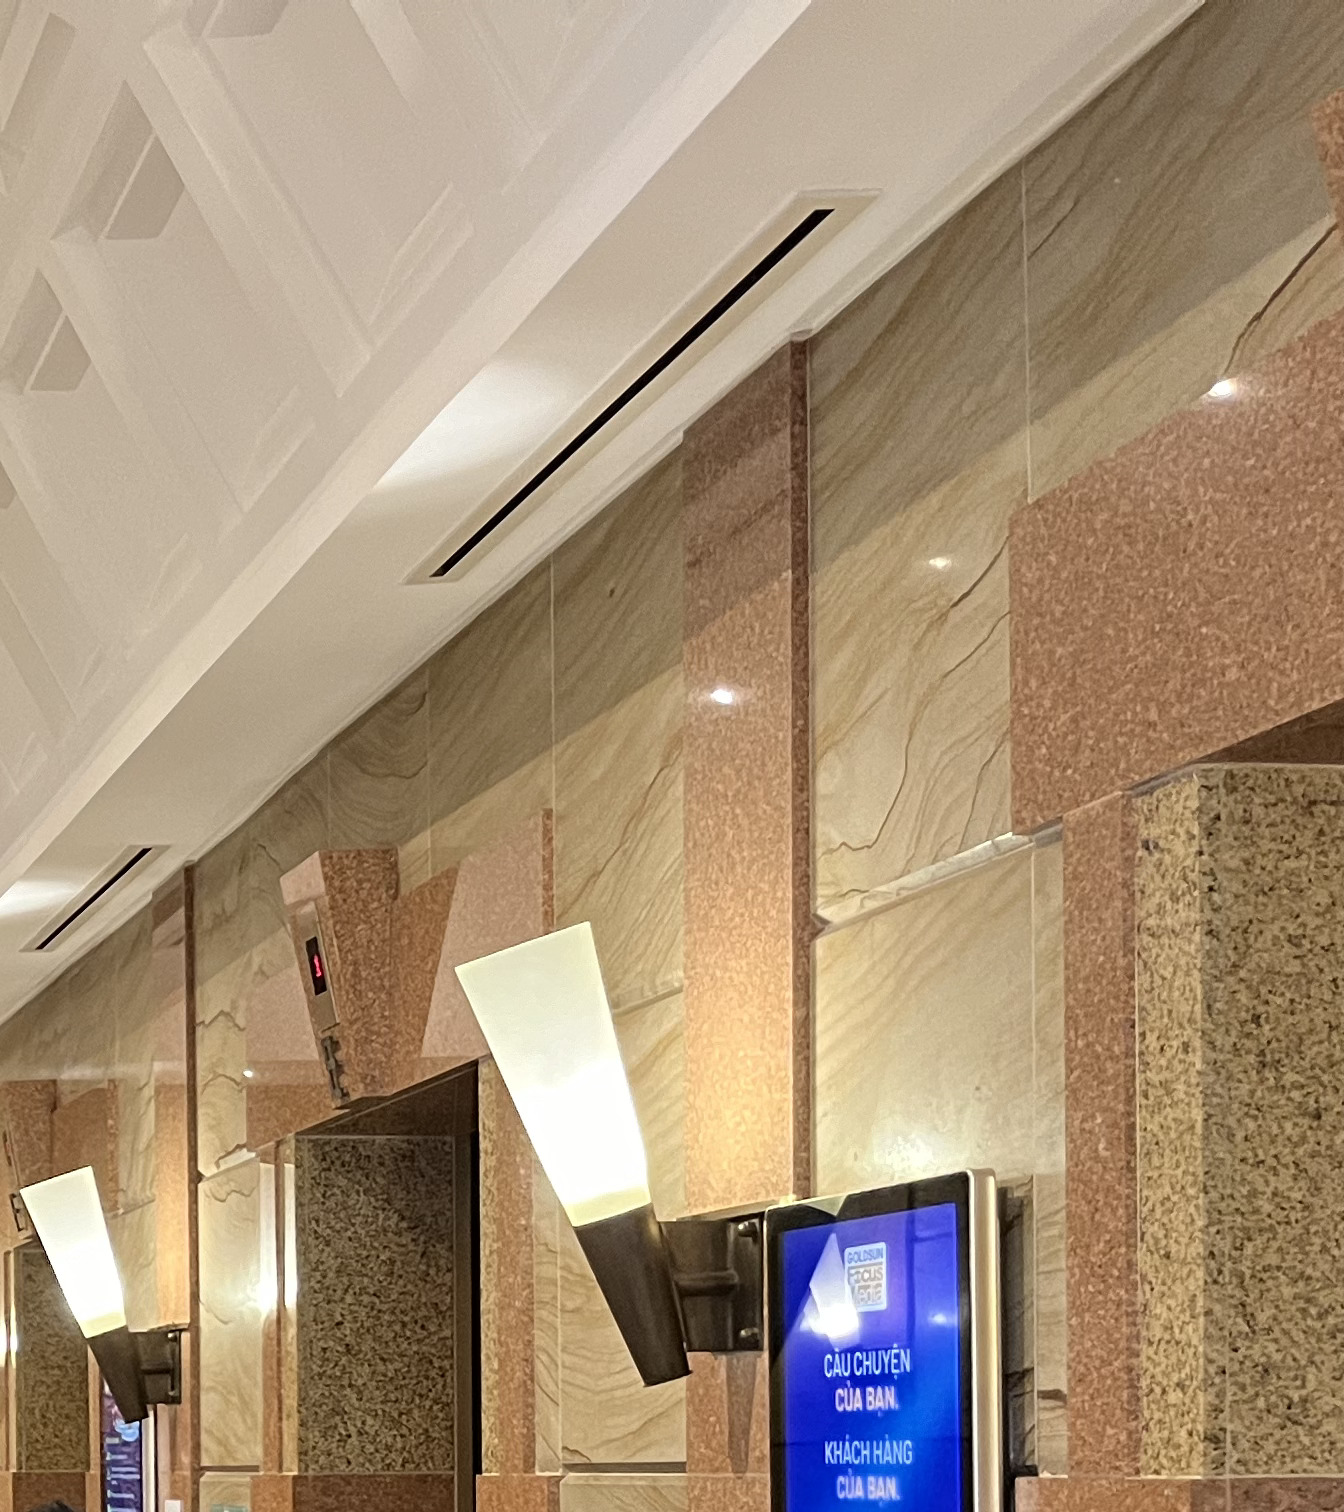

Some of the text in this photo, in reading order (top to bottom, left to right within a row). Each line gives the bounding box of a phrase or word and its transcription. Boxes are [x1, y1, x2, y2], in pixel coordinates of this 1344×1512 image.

[853, 1343, 911, 1380] CHUYỆN
[824, 1434, 913, 1465] KHÁCH HÀNG
